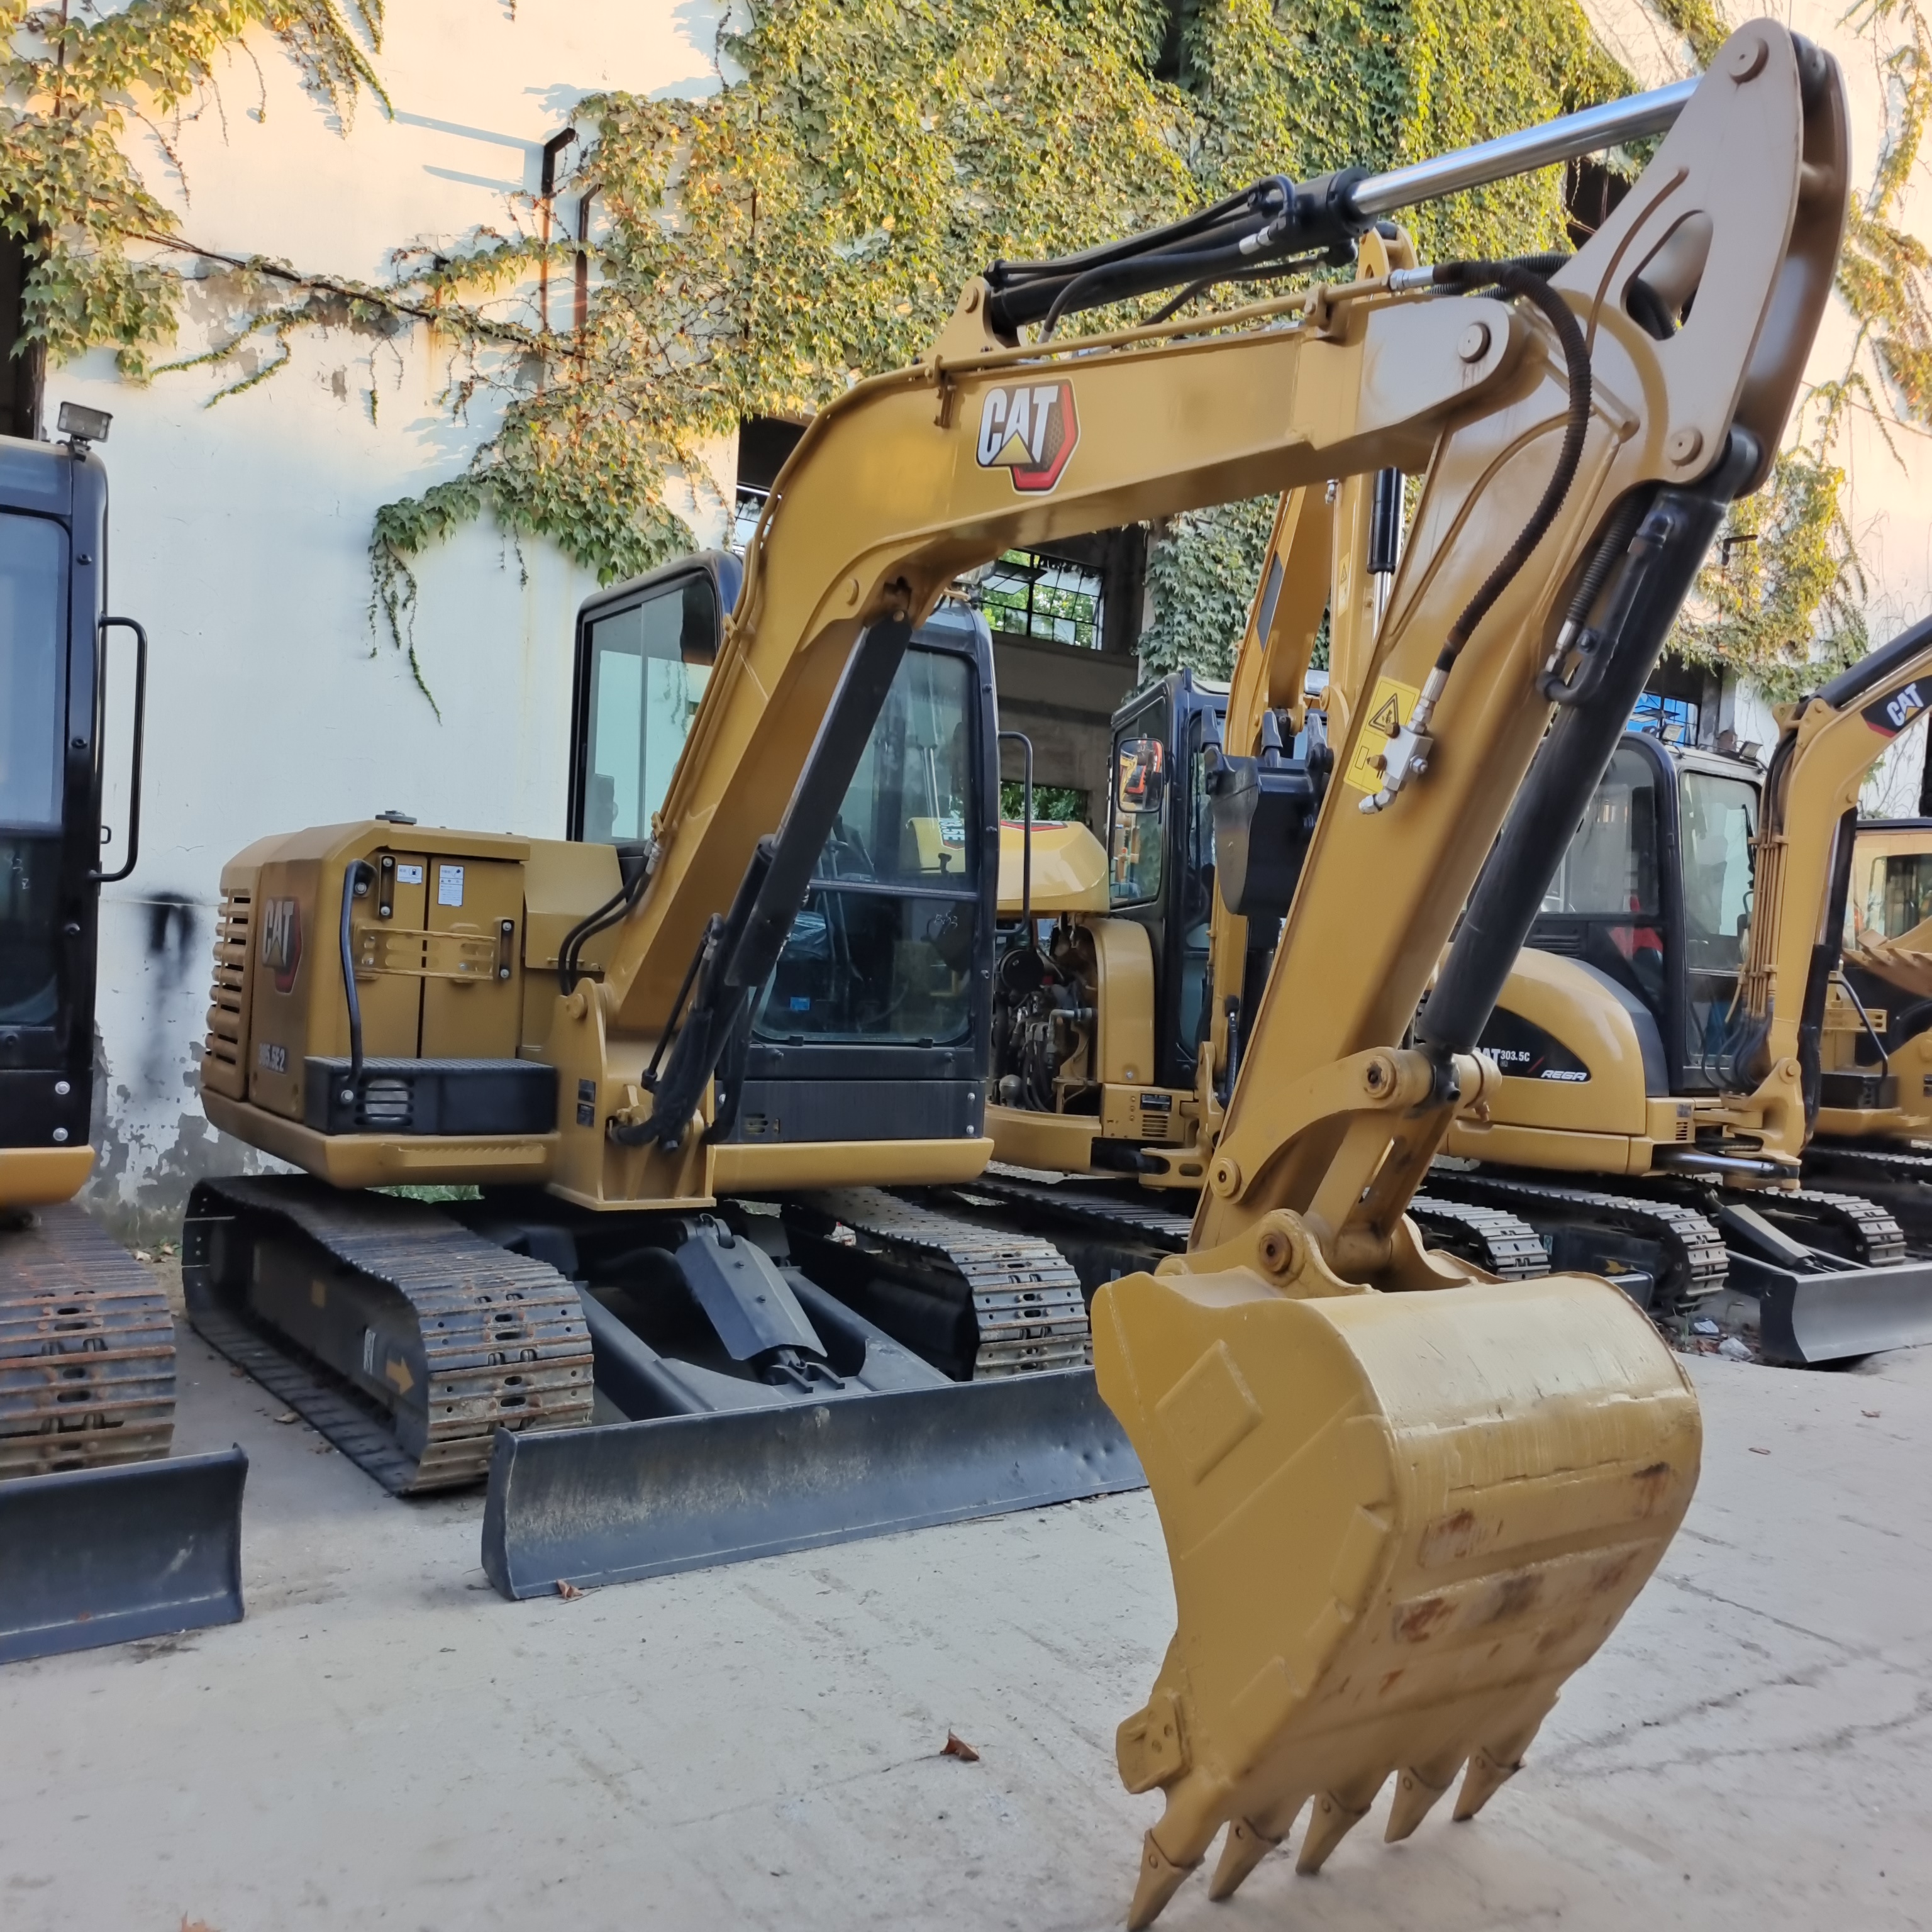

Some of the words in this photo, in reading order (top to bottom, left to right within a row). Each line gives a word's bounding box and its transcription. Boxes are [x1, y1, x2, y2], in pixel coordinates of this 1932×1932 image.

[977, 385, 1059, 465] CAT
[1886, 682, 1924, 726] CAT
[262, 899, 294, 967] CAT
[1475, 1046, 1501, 1065] AT
[1500, 1050, 1531, 1062] 303.5C
[1540, 1069, 1587, 1081] REGA
